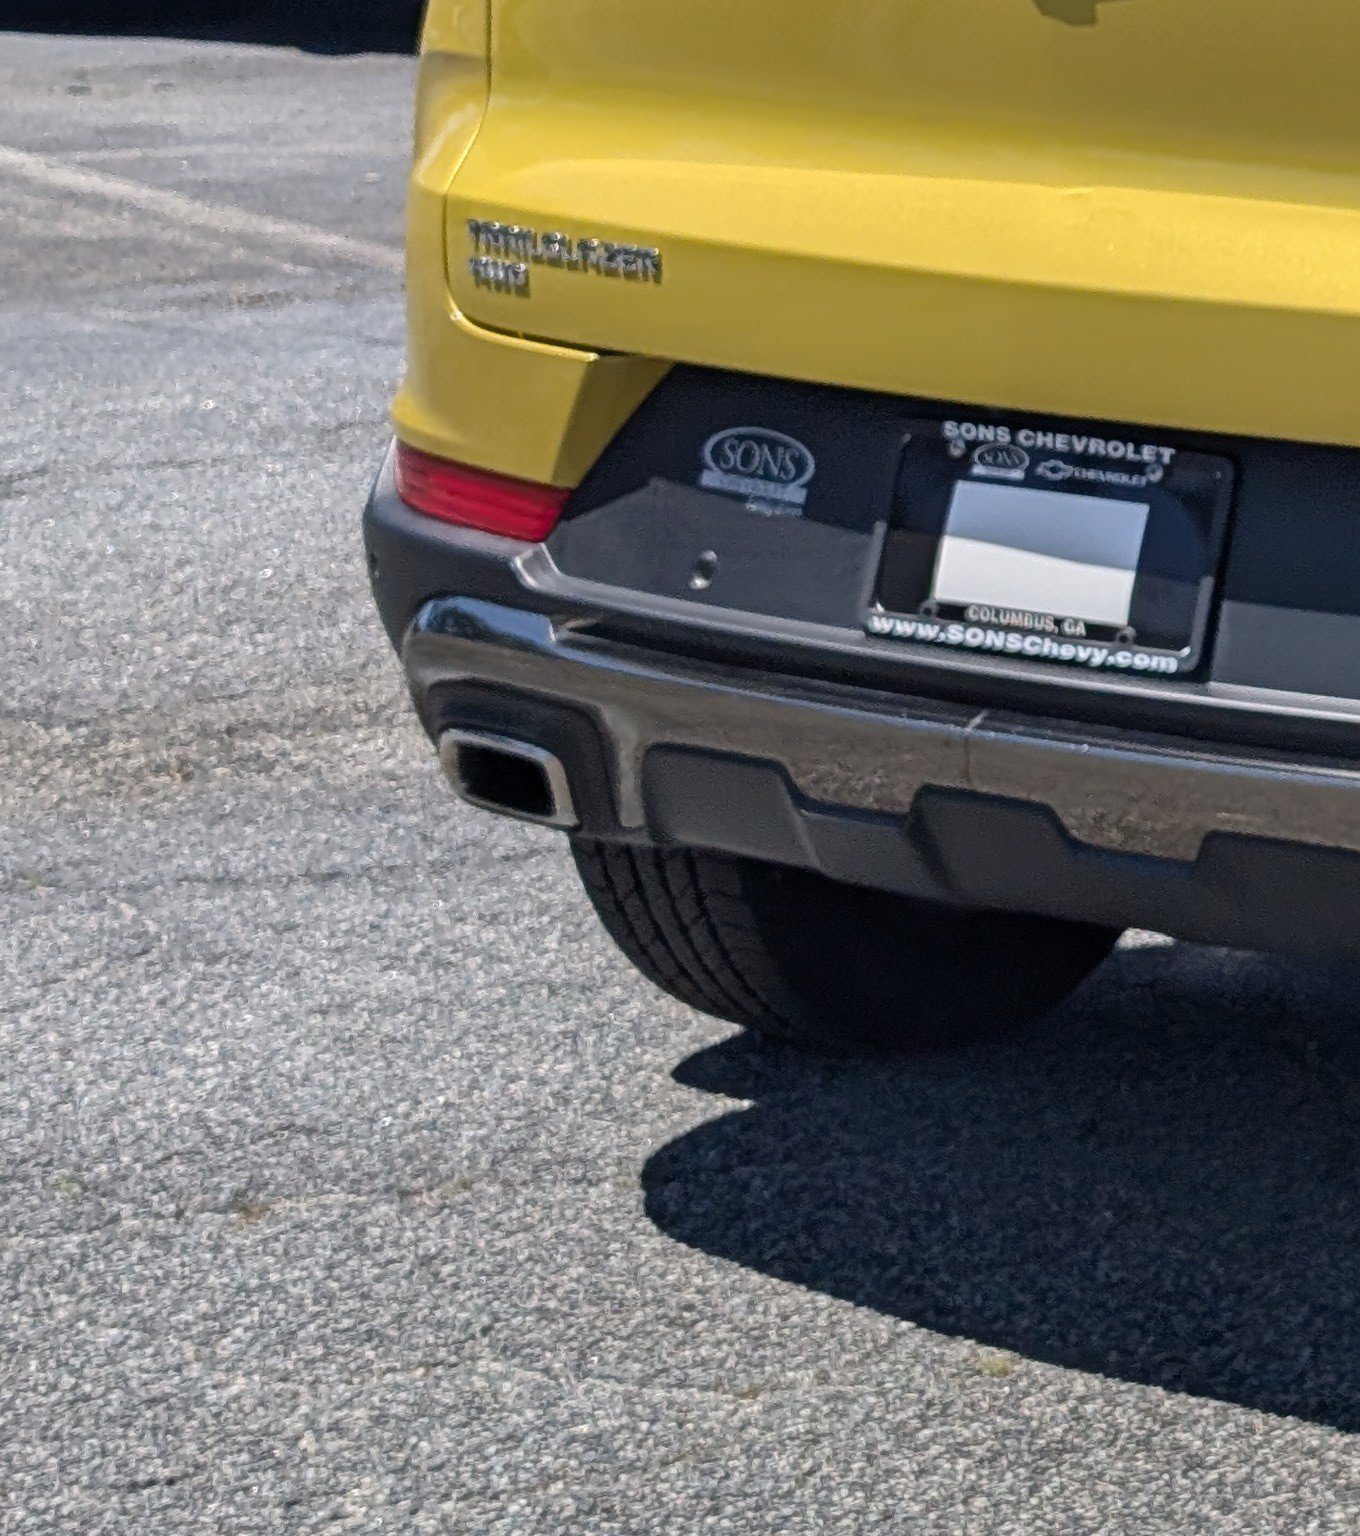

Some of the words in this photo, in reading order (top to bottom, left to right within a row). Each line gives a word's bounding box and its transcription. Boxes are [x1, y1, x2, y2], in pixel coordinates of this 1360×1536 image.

[720, 437, 797, 482] SONS
[941, 420, 1011, 445] SONS
[1016, 429, 1176, 465] CHEVROLET
[964, 603, 1059, 635] COLUMBUS,
[867, 615, 1179, 674] www.SONSChevy.com
